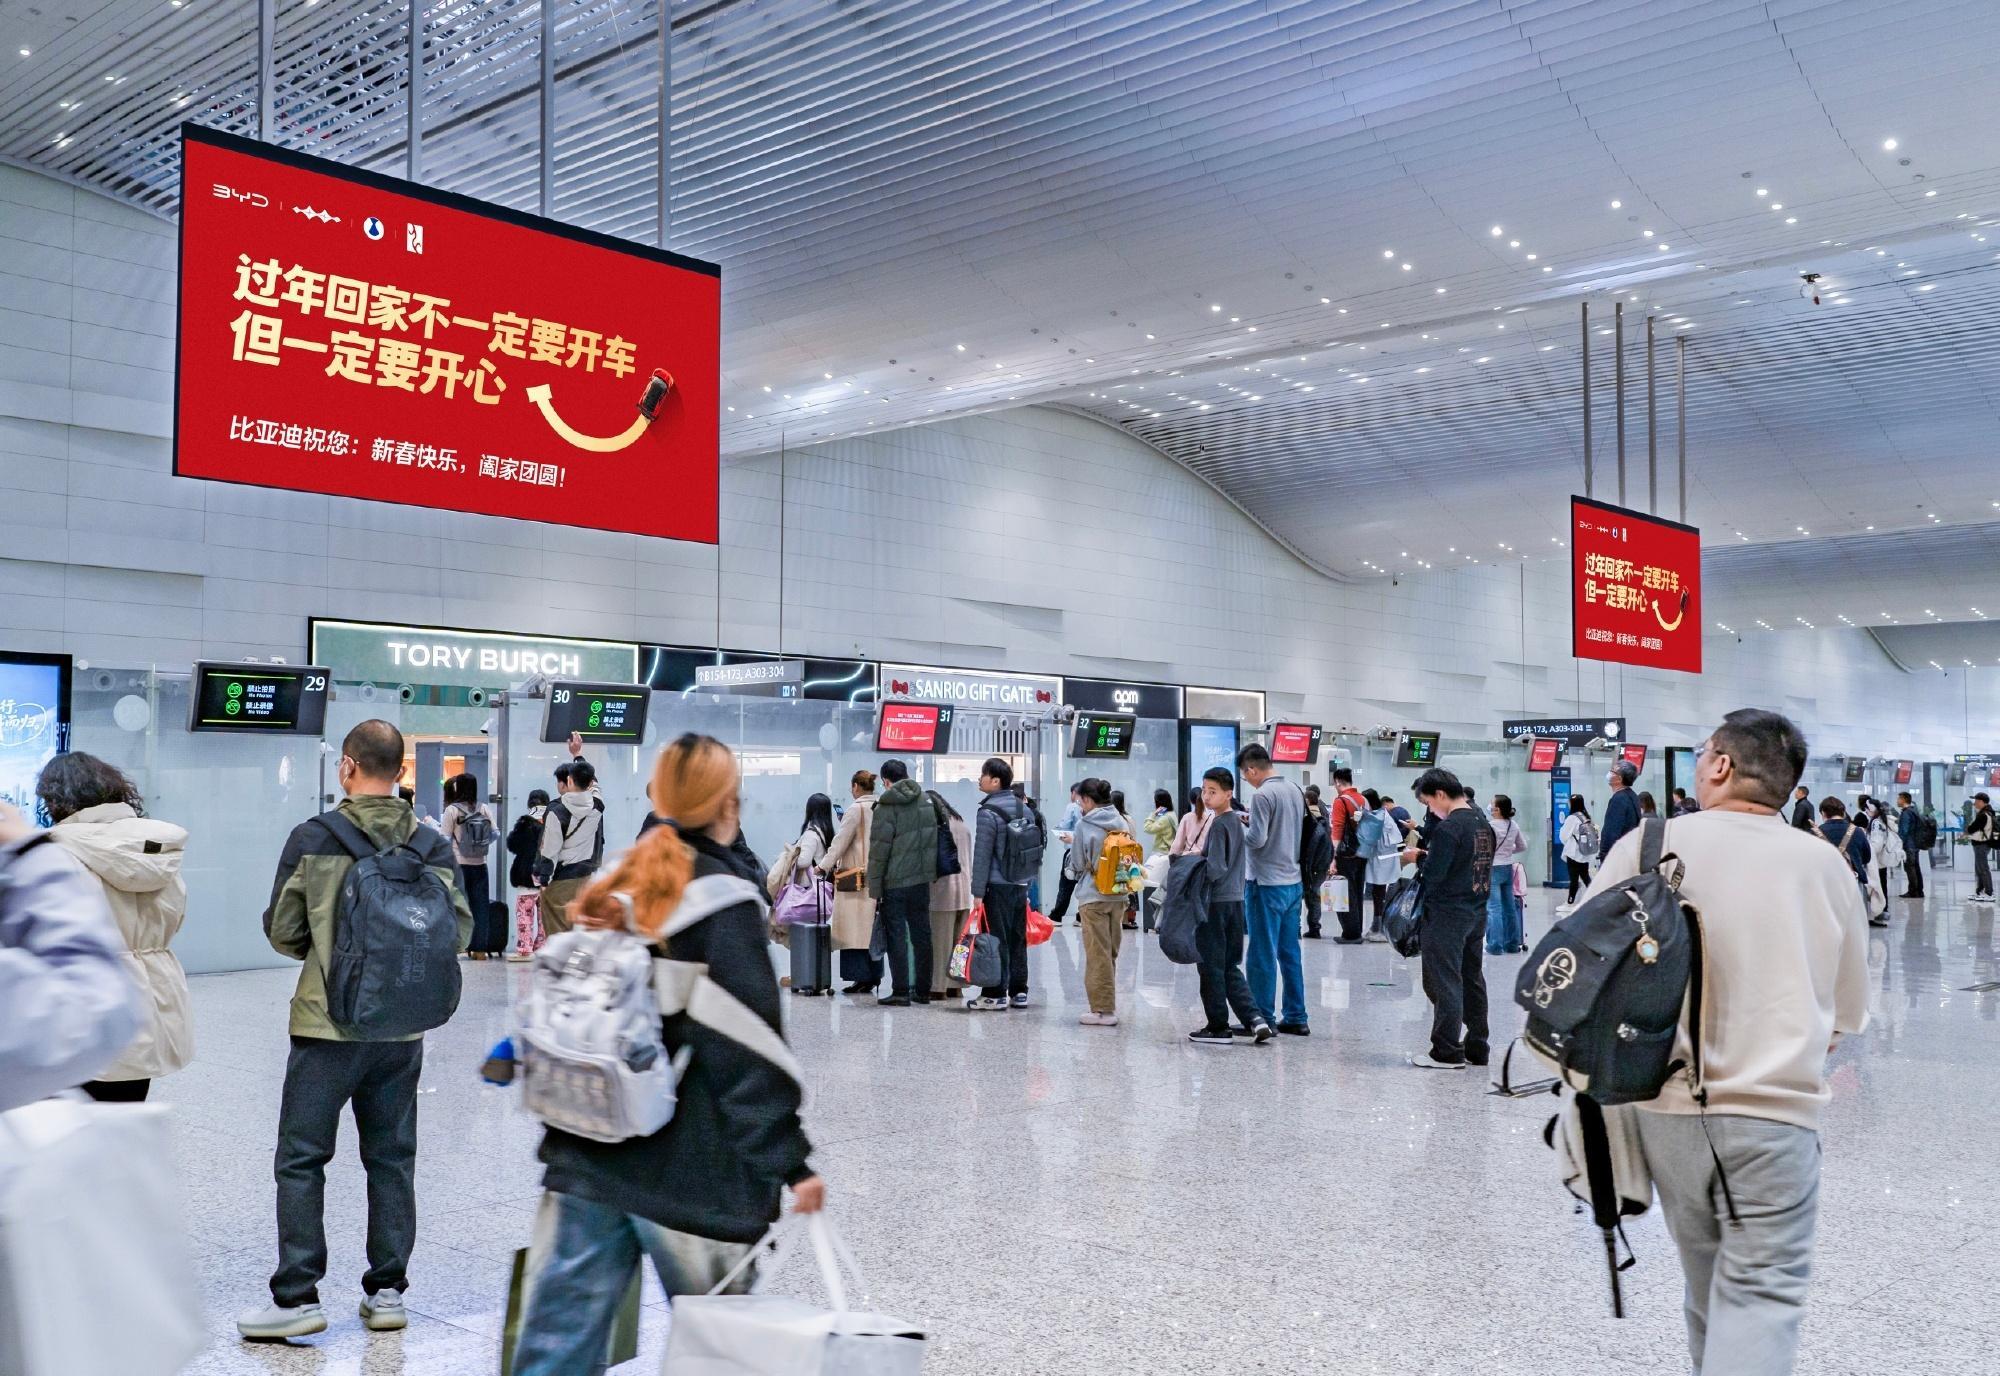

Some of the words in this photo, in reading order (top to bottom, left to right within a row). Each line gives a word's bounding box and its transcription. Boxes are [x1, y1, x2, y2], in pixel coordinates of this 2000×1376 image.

[213, 183, 269, 208] BYD
[233, 254, 637, 379] 过年回家不一定要开车
[230, 310, 507, 405] 但一定要开心
[1585, 552, 1680, 594] 过年回家不一定要开车
[1584, 578, 1648, 613] 但一定要开心
[387, 641, 473, 669] TORY
[479, 648, 580, 676] BURCH
[745, 665, 784, 678] A303-304
[305, 676, 326, 691] 29
[915, 679, 967, 700] SANRIO
[969, 682, 999, 702] GIFT
[1000, 685, 1033, 704] GATE
[553, 689, 570, 703] 30
[1114, 689, 1139, 707] apm
[940, 709, 951, 722] 31
[1079, 718, 1090, 729] 32
[1312, 729, 1321, 738] 33
[1550, 724, 1584, 733] A303-304
[1401, 734, 1409, 743] 34
